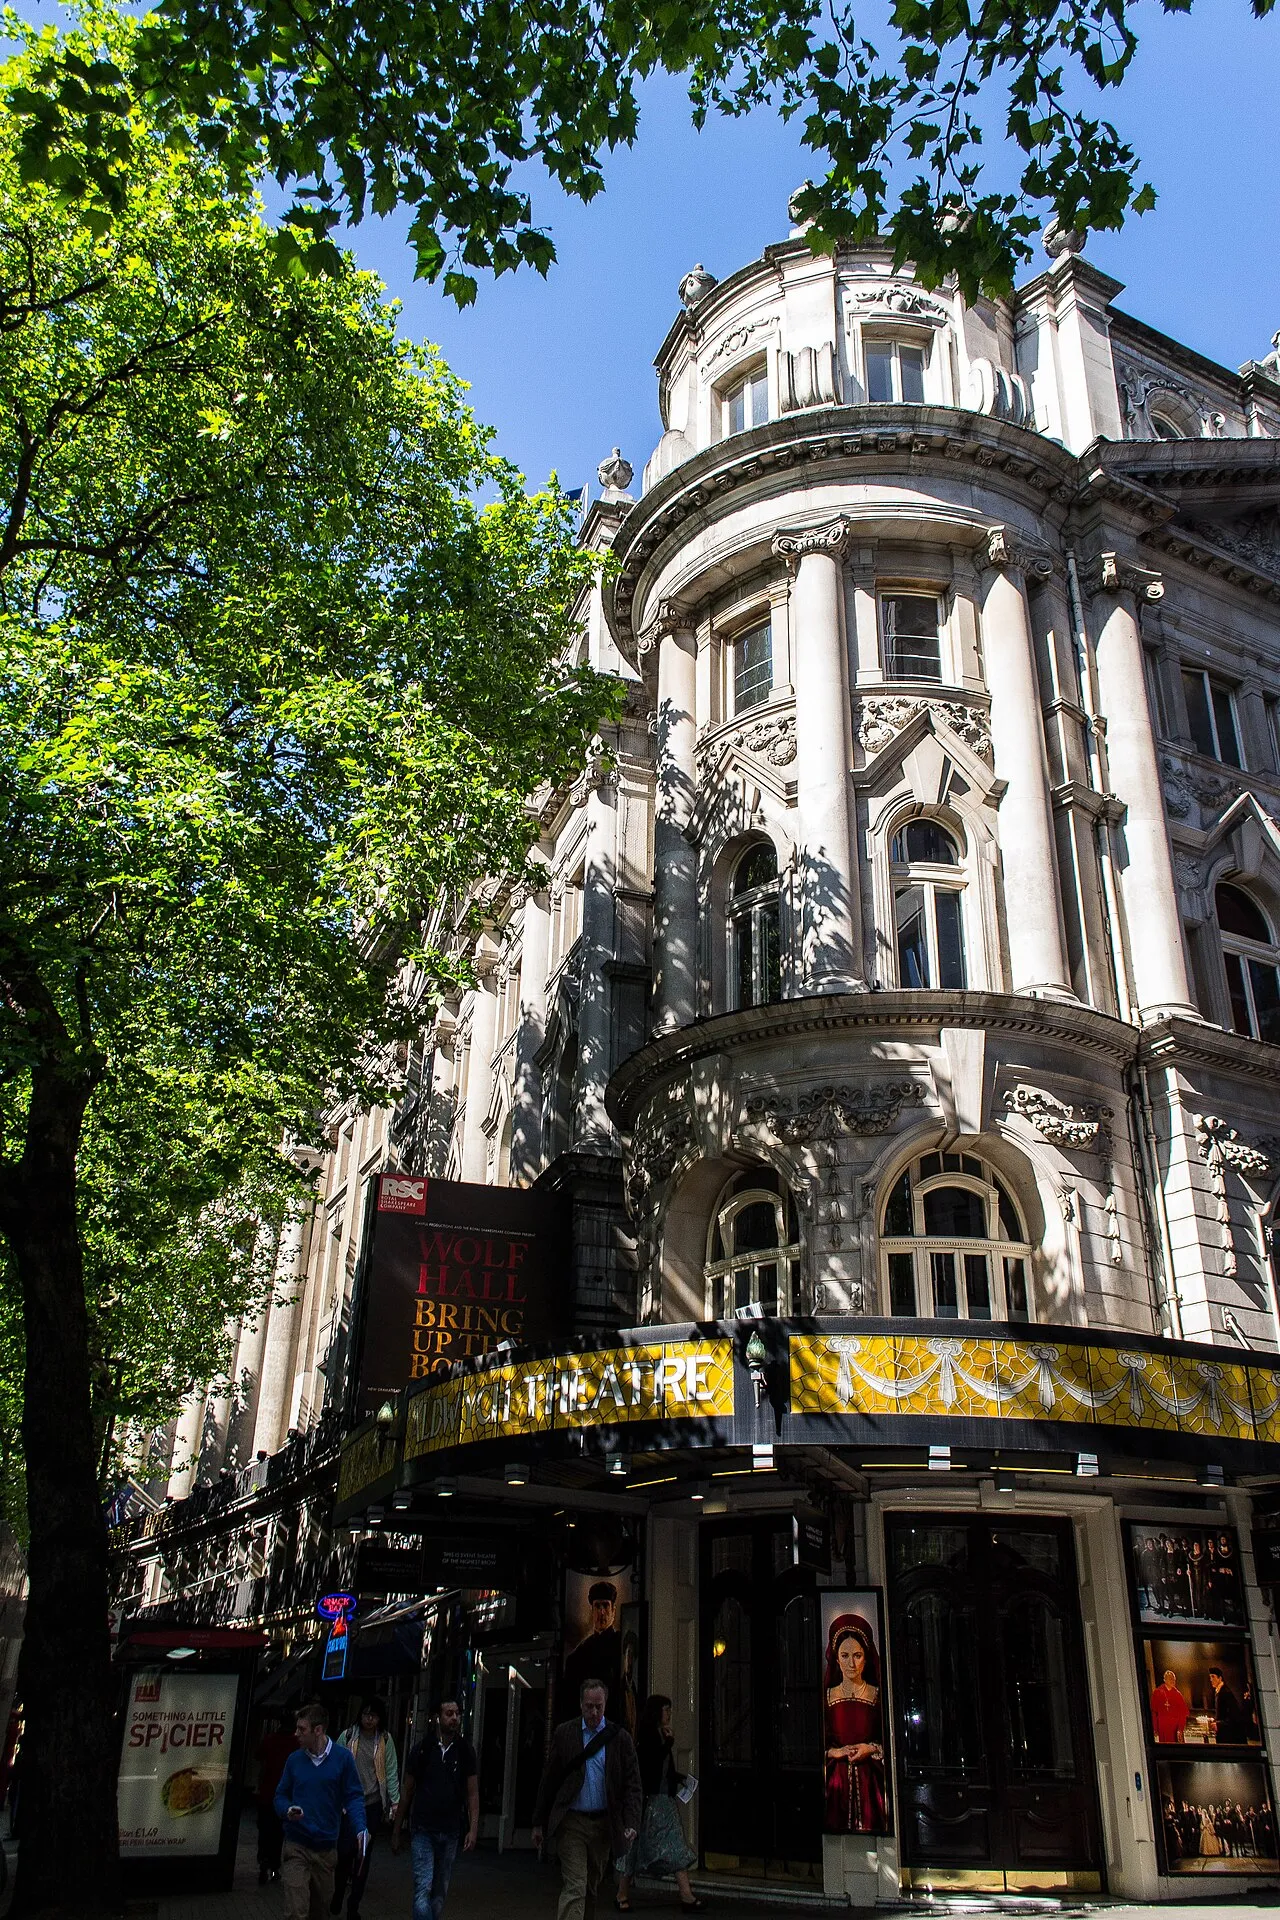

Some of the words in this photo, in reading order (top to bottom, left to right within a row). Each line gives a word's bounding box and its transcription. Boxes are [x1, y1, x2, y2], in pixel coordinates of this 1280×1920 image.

[381, 1177, 425, 1201] RSC
[416, 1230, 529, 1270] WOLF
[414, 1262, 528, 1303] HALL
[412, 1298, 525, 1335] BRING
[411, 1329, 453, 1355] UP
[457, 1333, 523, 1357] TH
[523, 1355, 716, 1418] THEATRE
[323, 1597, 350, 1607] SNACK
[132, 1711, 186, 1722] SOMETHING
[187, 1711, 195, 1721] A
[196, 1711, 227, 1721] LITTLE
[128, 1723, 225, 1753] SPICIER
[145, 1838, 166, 1846] SNACK
